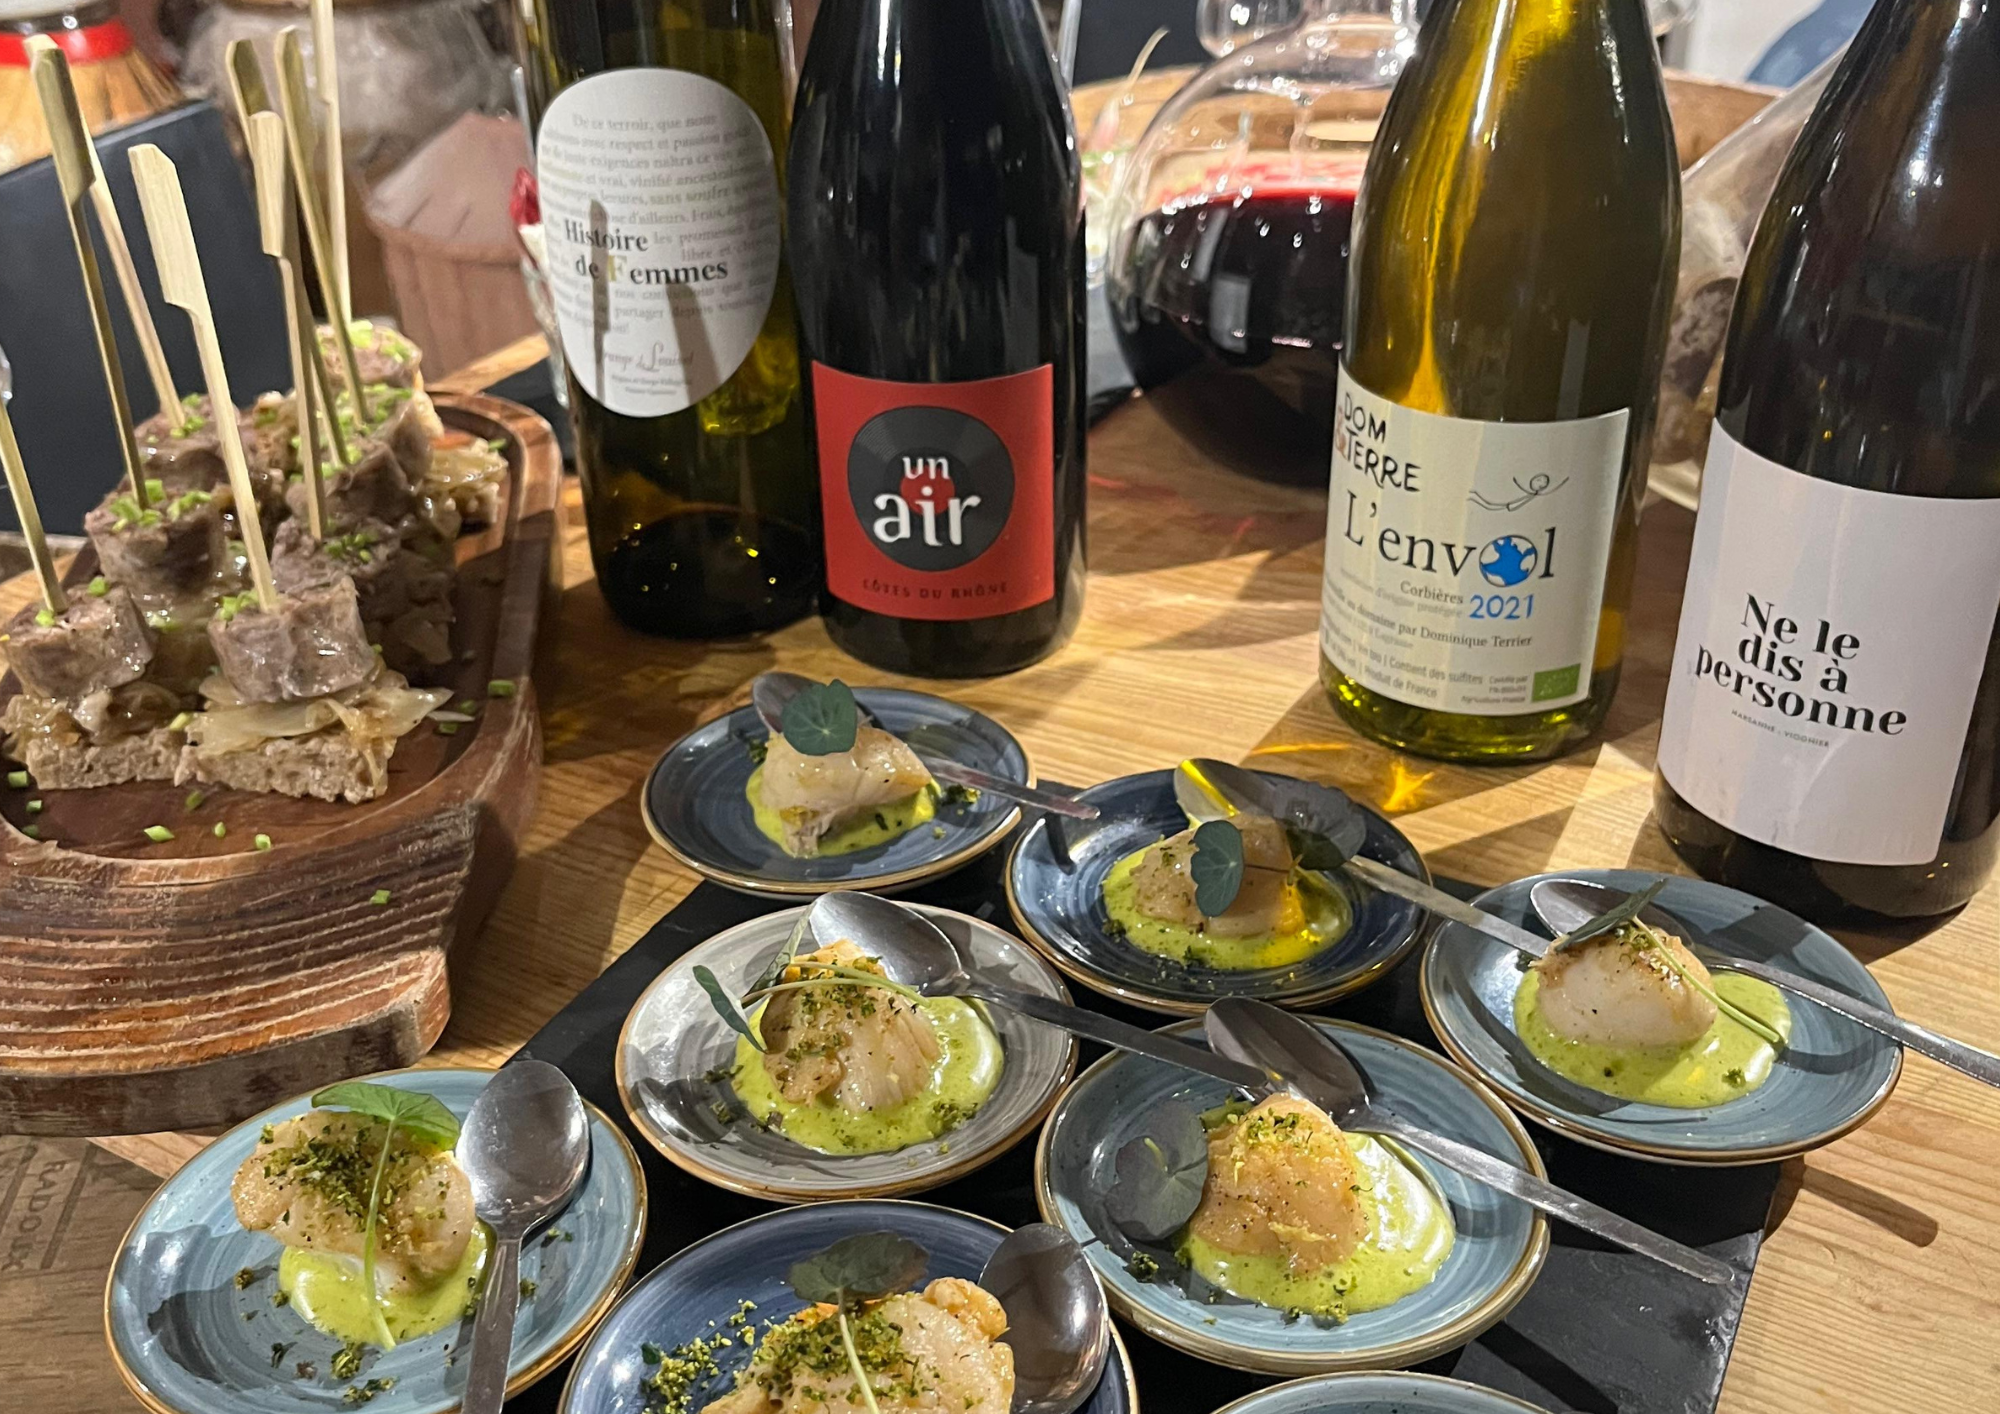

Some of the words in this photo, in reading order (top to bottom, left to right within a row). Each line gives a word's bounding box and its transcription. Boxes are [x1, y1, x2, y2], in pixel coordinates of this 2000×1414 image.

[564, 218, 650, 252] Histoire
[575, 254, 600, 280] de
[1344, 391, 1386, 444] DOM
[902, 456, 950, 480] un
[1346, 425, 1421, 492] TERRE
[873, 486, 981, 546] air
[863, 579, 910, 598] CÔTES
[919, 587, 942, 599] DU
[951, 581, 1008, 599] RHÔNE
[1400, 580, 1464, 605] Corbières
[1469, 594, 1535, 620] 2021
[1398, 622, 1418, 637] par
[1420, 626, 1488, 649] Dominique
[1491, 635, 1533, 648] Terrier
[1740, 592, 1798, 645] Ne
[1812, 618, 1860, 660] le
[1738, 633, 1804, 683] dis
[1819, 658, 1848, 694] à
[1695, 643, 1907, 736] personne
[1731, 709, 1775, 733] MARSANNE
[1784, 730, 1830, 748] VIOGNIER
